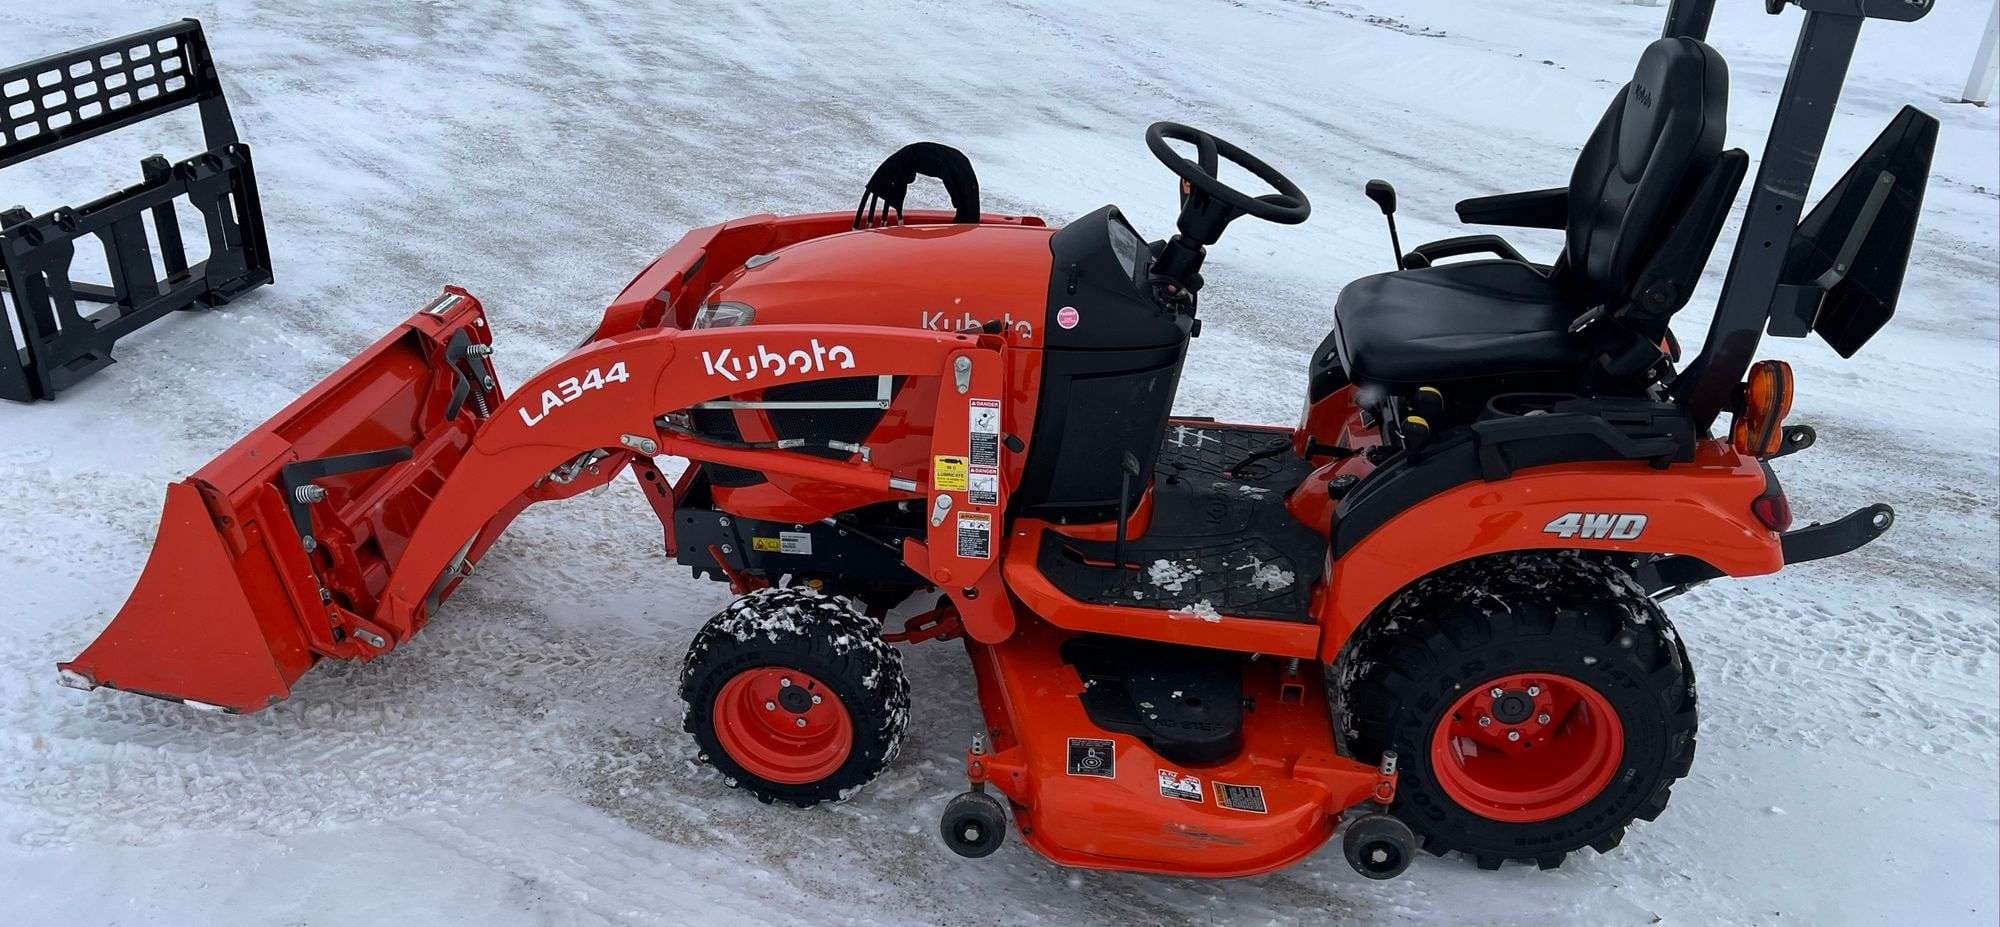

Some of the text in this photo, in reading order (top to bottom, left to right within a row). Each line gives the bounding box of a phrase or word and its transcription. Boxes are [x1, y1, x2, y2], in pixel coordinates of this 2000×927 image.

[922, 311, 1032, 339] Kubta
[702, 338, 856, 382] Kubota
[518, 361, 630, 427] LA344
[1543, 512, 1648, 540] 4WD
